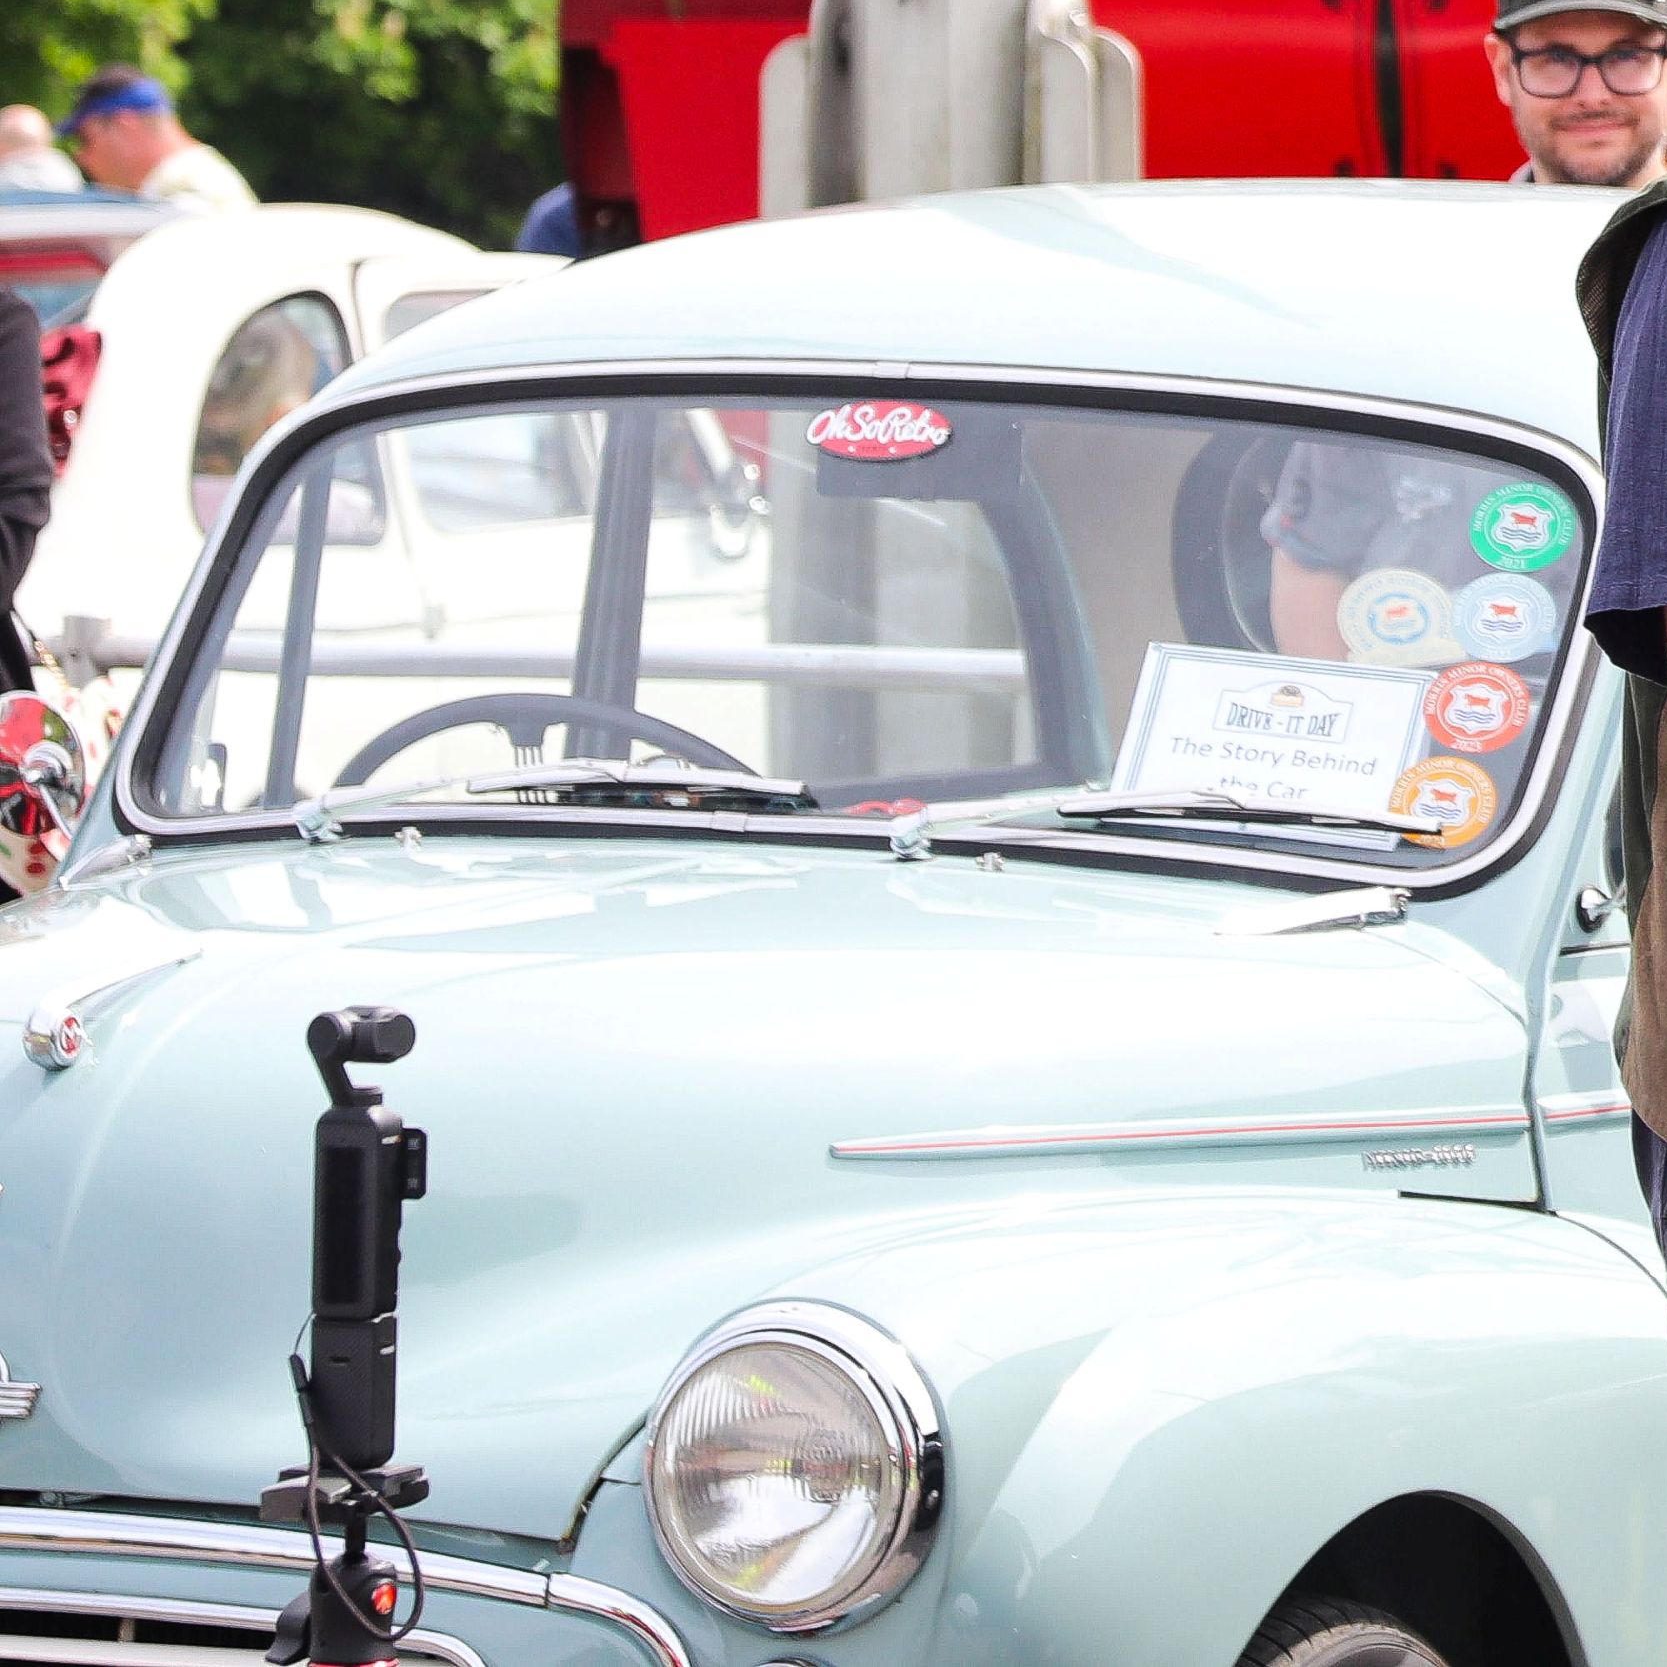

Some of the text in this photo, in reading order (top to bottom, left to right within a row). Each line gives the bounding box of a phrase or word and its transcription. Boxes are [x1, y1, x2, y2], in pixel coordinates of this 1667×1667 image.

[1226, 702, 1273, 730] DRIVE
[1307, 712, 1342, 737] DAY
[1171, 736, 1378, 777] The Story Behind
[1266, 780, 1308, 800] Car
